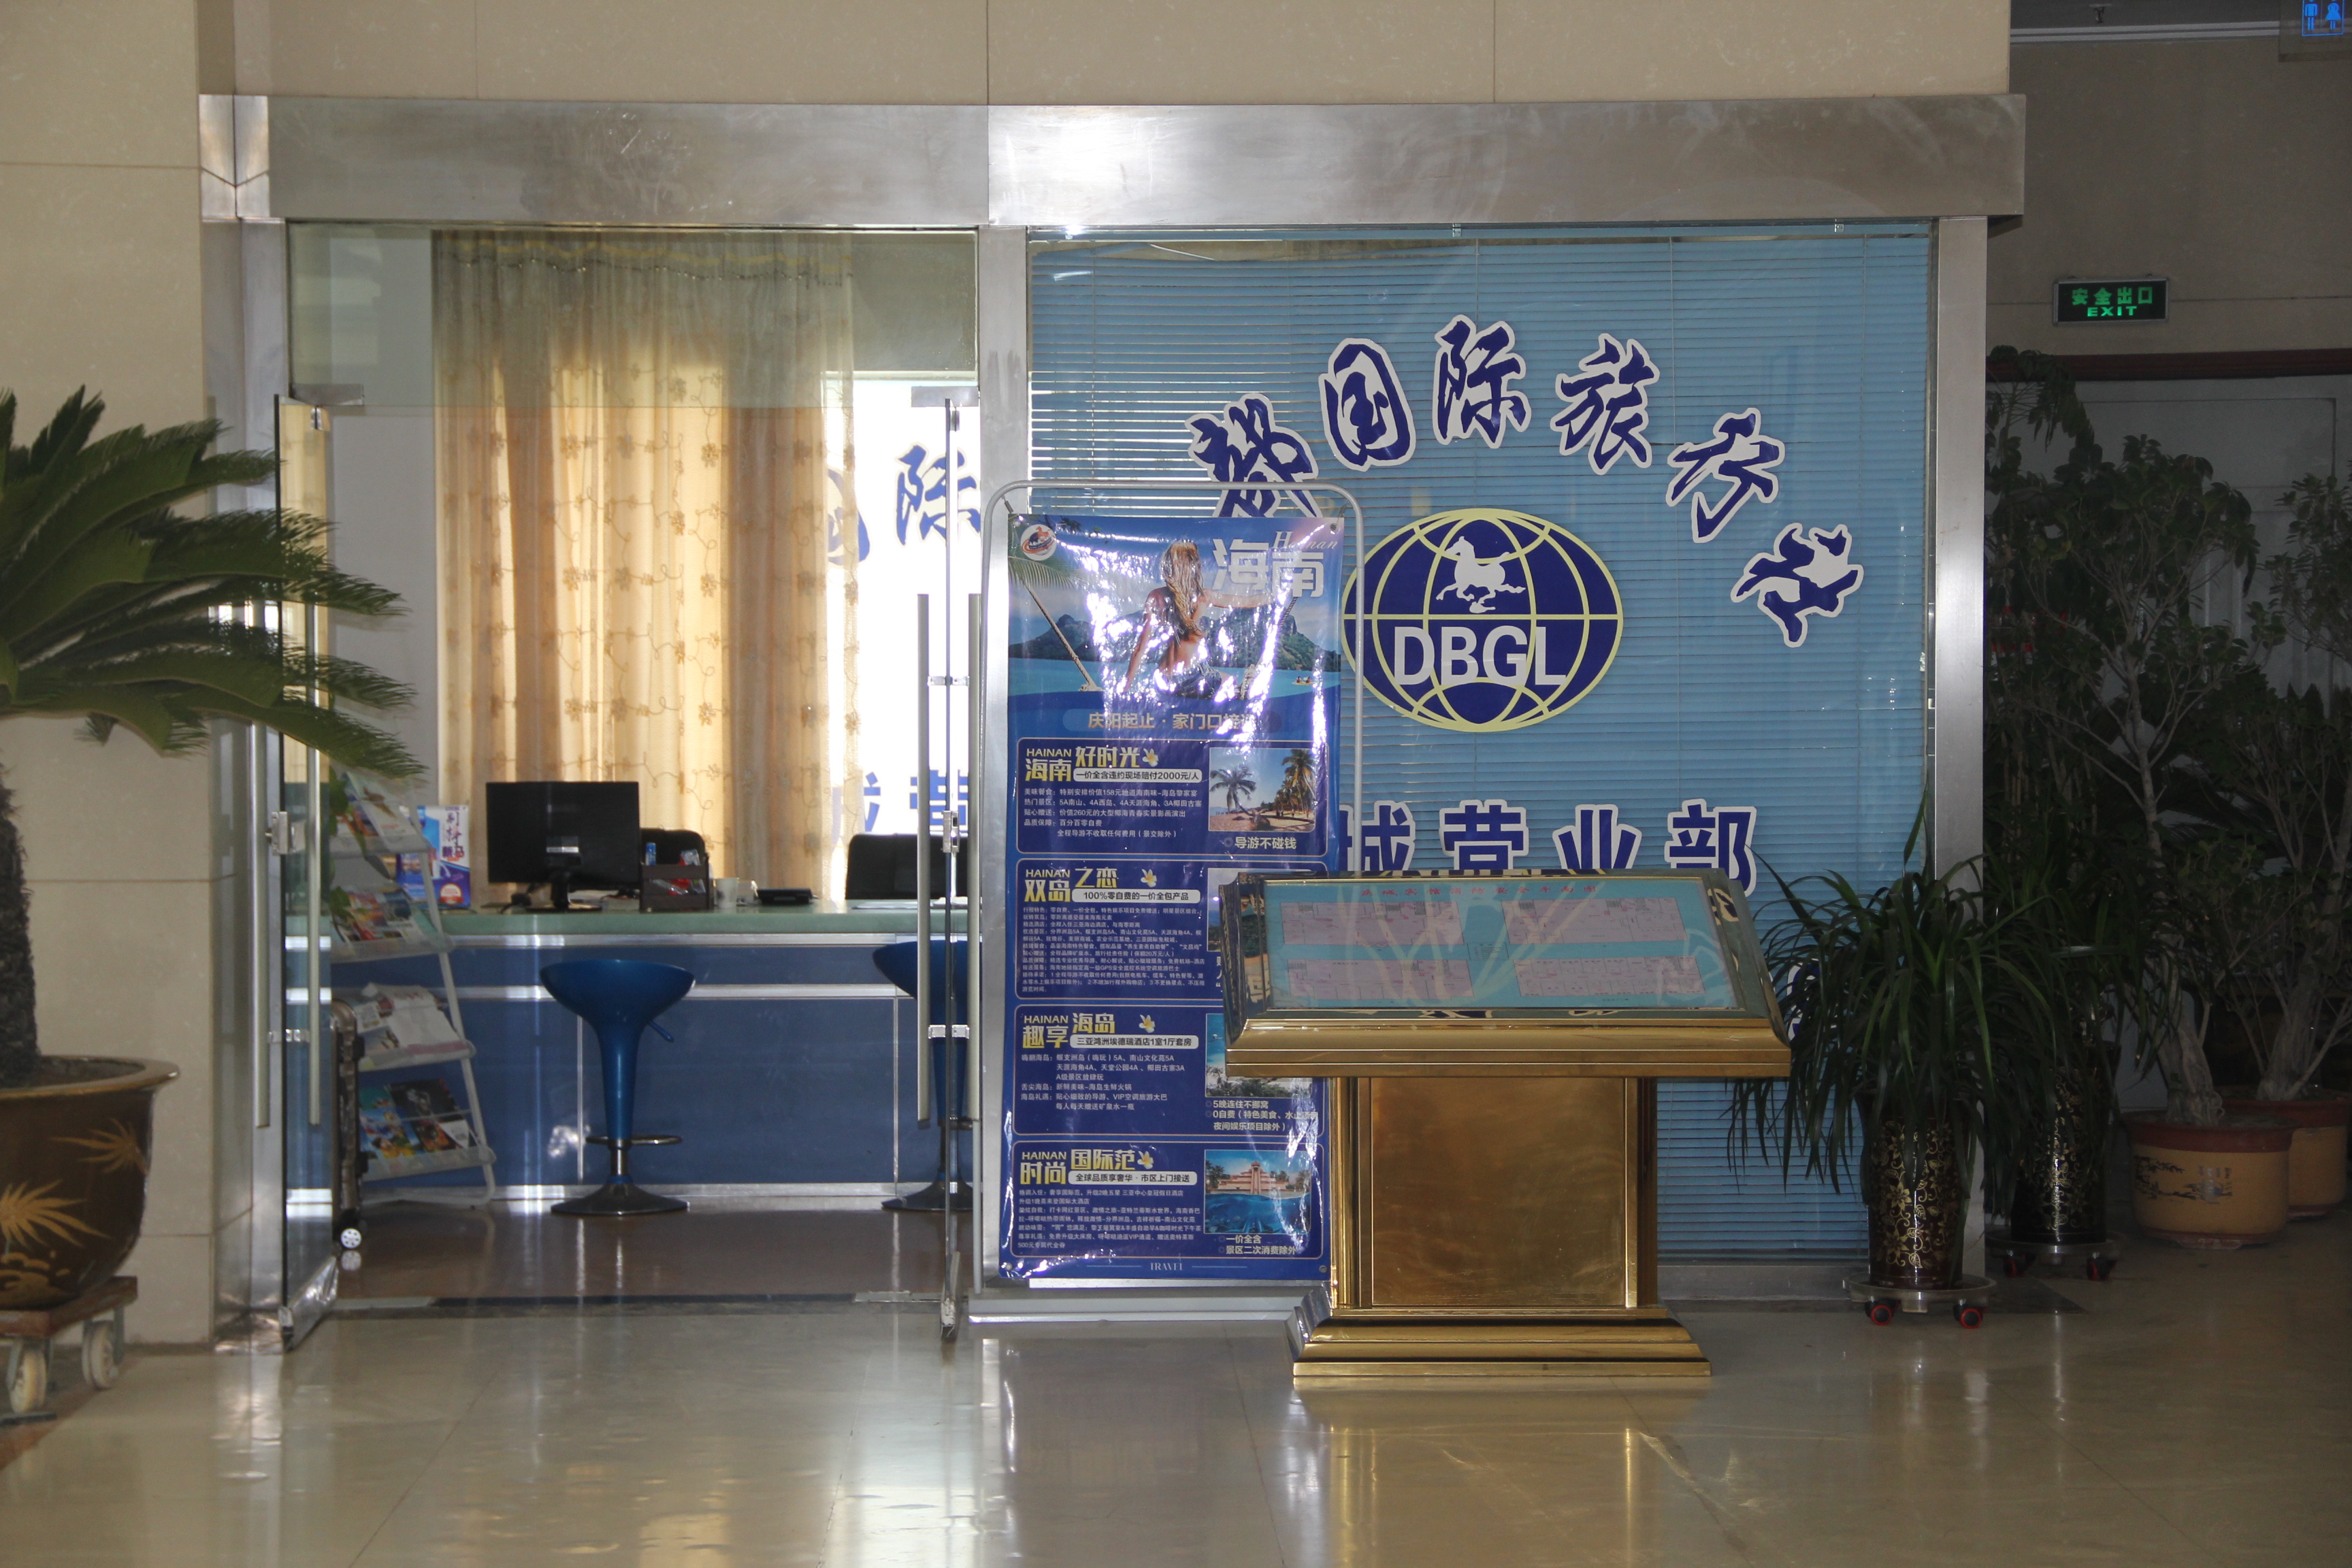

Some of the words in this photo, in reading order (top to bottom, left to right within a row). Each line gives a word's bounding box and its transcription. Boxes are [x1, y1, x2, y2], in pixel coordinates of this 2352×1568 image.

[2072, 286, 2153, 306] 安全出口
[2087, 306, 2137, 316] EXIT
[1212, 538, 1324, 598] 海南
[1394, 625, 1567, 686] DBGL
[1026, 749, 1072, 757] HAINAN
[1075, 746, 1140, 768] 好时光
[1025, 758, 1072, 782] 海南
[1075, 770, 1199, 781] 一价全含违约现场赔付2000元/人
[1235, 836, 1297, 849] 导游不碰钱
[1026, 869, 1071, 878] HAINAN
[1075, 868, 1117, 888] 之恋
[1024, 879, 1071, 902] 双岛
[1083, 892, 1189, 901] 100%零自费的一价全包产品
[1072, 1012, 1115, 1033] 海岛
[1022, 1025, 1068, 1049] 趣享
[1022, 1152, 1067, 1160] HAINAN
[1071, 1149, 1135, 1171] 国际范
[1020, 1161, 1066, 1185] 时尚
[1226, 1235, 1262, 1244] 一价全含
[1226, 1245, 1296, 1255] 景区二次消费除外
